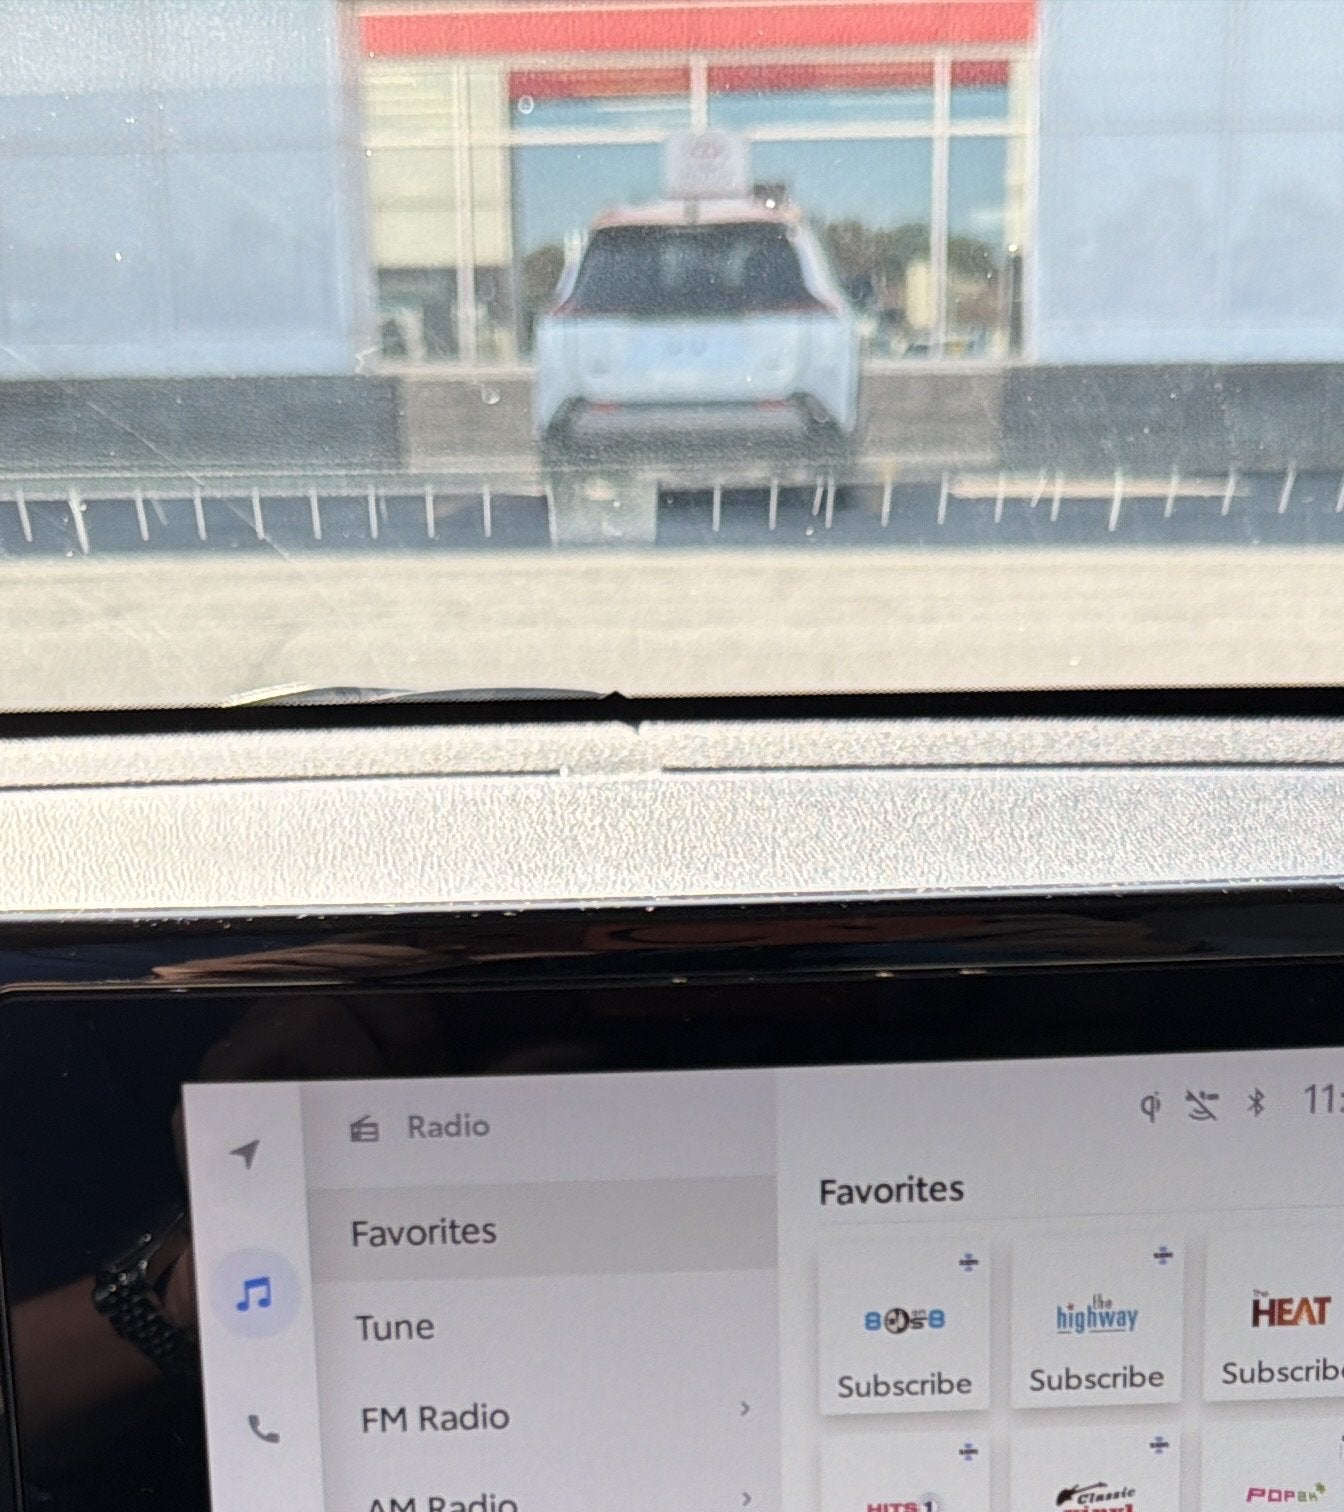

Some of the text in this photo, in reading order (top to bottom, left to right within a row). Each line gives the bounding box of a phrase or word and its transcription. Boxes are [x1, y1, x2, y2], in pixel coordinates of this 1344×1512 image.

[407, 1113, 492, 1141] Radio
[818, 1174, 966, 1207] Favorites
[350, 1217, 498, 1248] Favorites
[1091, 1292, 1113, 1310] the
[1252, 1296, 1333, 1328] HEAT
[355, 1314, 436, 1342] Tune
[1055, 1303, 1139, 1335] highway
[838, 1371, 973, 1399] Subscribe
[1028, 1364, 1165, 1392] Subscribe
[361, 1403, 512, 1434] FM Radio
[1076, 1486, 1136, 1506] Classic
